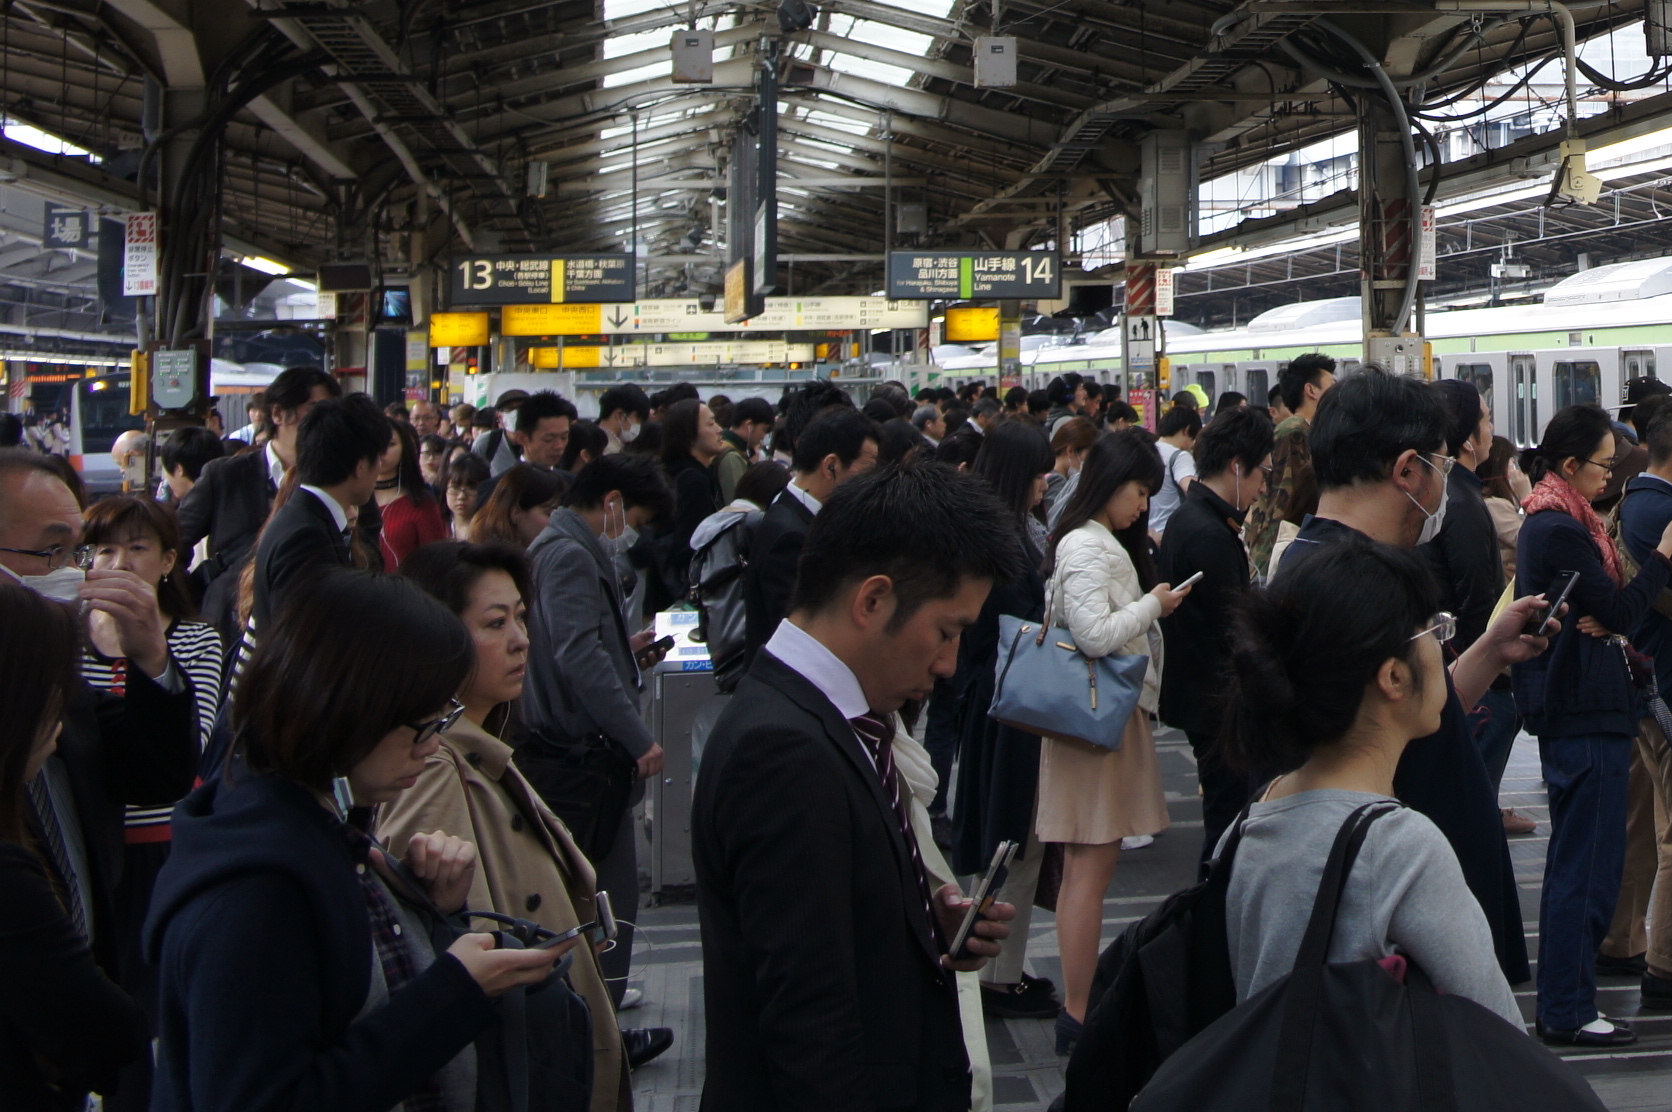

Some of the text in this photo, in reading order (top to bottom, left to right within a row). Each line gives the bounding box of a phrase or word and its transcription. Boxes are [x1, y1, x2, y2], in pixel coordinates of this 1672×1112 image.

[51, 217, 82, 243] 場
[912, 258, 958, 268] 原宿・渋谷
[974, 257, 1016, 272] 山手線
[458, 259, 493, 290] 13
[918, 269, 958, 279] 品川方面
[1021, 257, 1054, 284] 14
[974, 273, 1016, 282] Yamanote
[974, 283, 992, 291] Line
